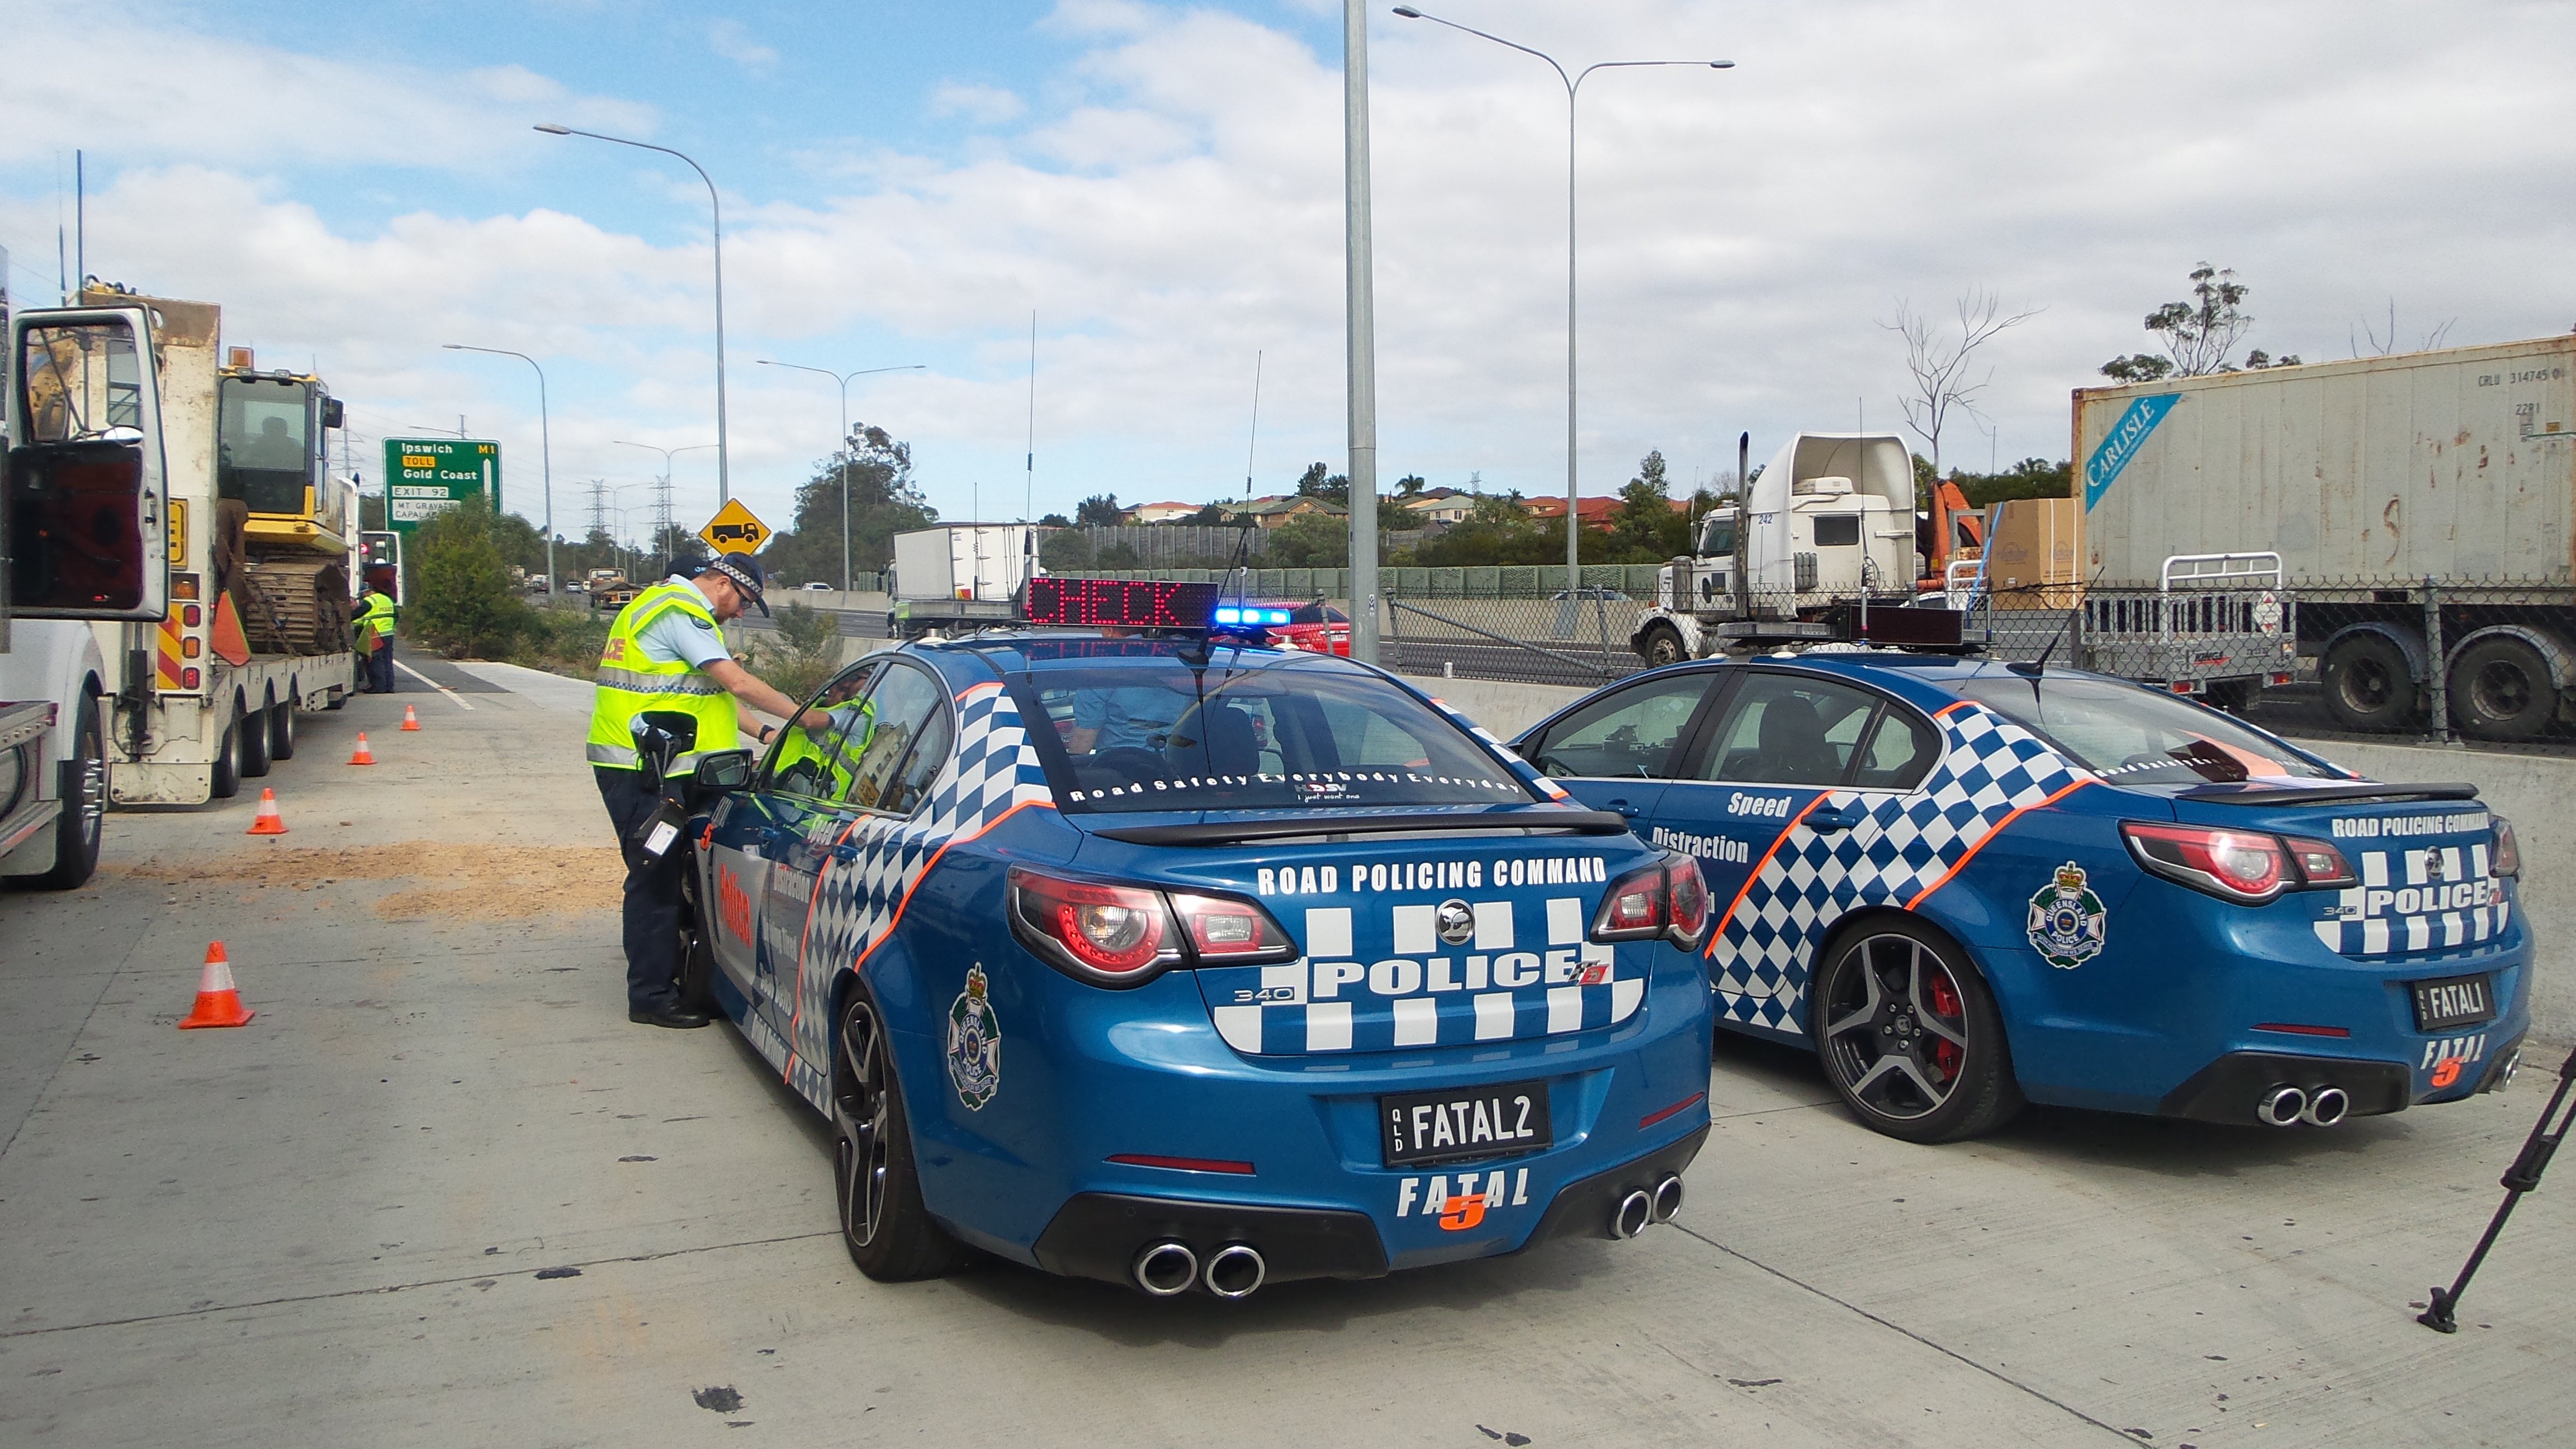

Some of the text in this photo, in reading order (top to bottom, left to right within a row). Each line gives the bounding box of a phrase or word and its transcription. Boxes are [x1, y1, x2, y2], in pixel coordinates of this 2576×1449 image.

[2510, 370, 2547, 383] 314745
[401, 443, 495, 454] Ipswich M1
[2087, 399, 2155, 487] CARLISLE
[403, 468, 477, 480] Gold Coast
[406, 457, 433, 466] TOLL
[394, 487, 423, 496] EXIT
[1758, 514, 1773, 525] 242
[1027, 578, 1181, 626] CHECK
[2094, 764, 2138, 777] Road
[2138, 759, 2194, 770] Safety
[1069, 770, 1519, 802] Road Safety Everybody Everyday
[1304, 792, 1321, 803] just
[1727, 792, 1792, 817] Speed
[700, 823, 714, 850] 5
[2332, 812, 2490, 837] ROAD POLICING COMMAN
[1652, 826, 1749, 863] Distraction
[1257, 857, 1606, 895] ROAD POLICING COMMAND
[2045, 899, 2087, 927] QUEENSLAND
[2367, 881, 2487, 916] POLICE
[2051, 930, 2080, 944] POLICE
[1313, 949, 1578, 997] POLICE
[1234, 988, 1295, 1001] 340
[2430, 982, 2485, 1019] FATAL1
[959, 1016, 987, 1054] QUEENSLAND
[963, 1056, 982, 1076] POLICE
[2420, 1034, 2486, 1070] FATAL
[2431, 1056, 2464, 1087] 5
[1392, 1109, 1403, 1152] QLD
[1412, 1096, 1533, 1149] FATAL2
[1396, 1168, 1528, 1217] FATAL
[1439, 1193, 1486, 1230] 5
